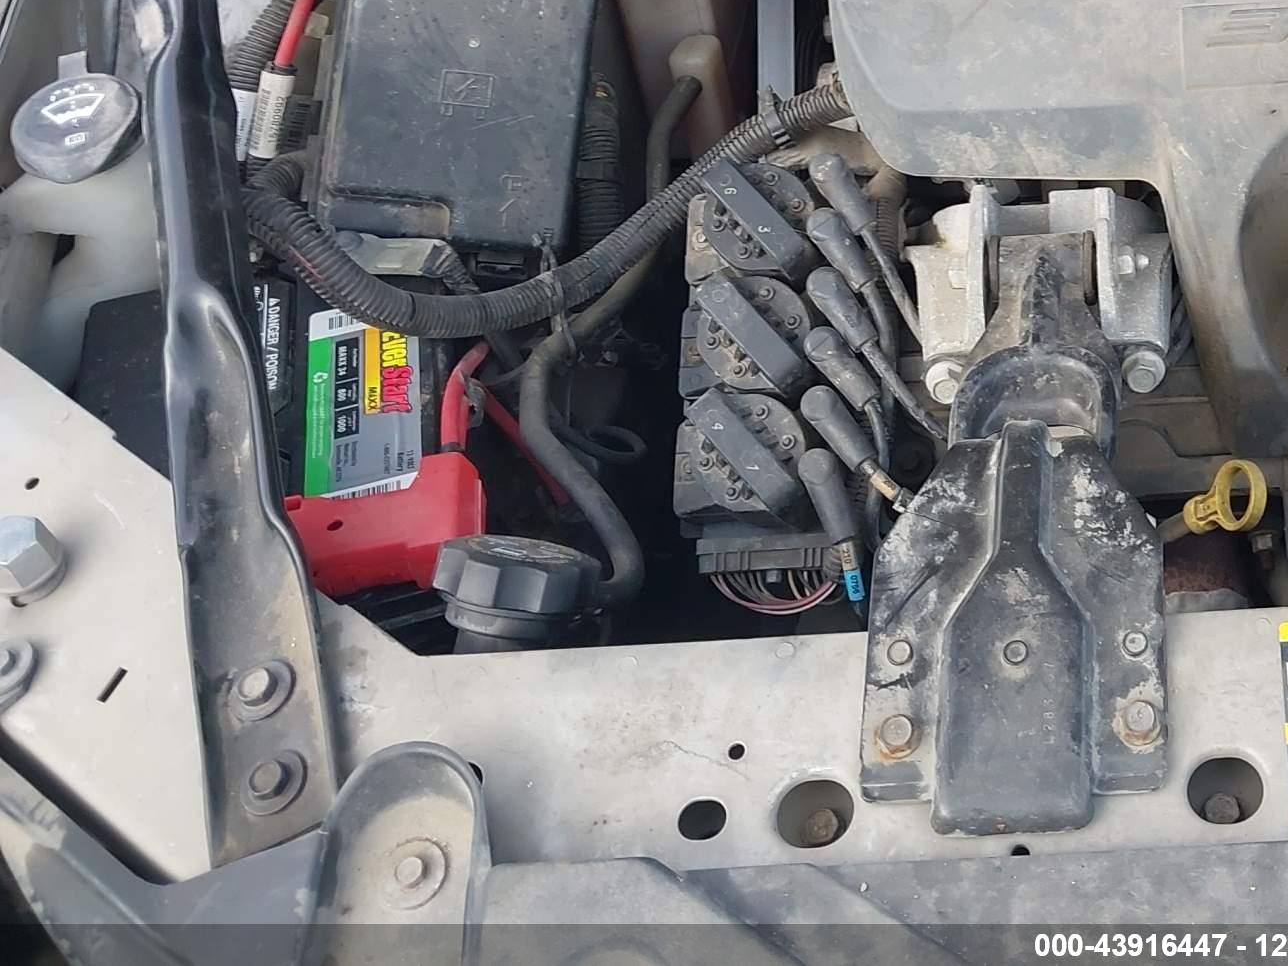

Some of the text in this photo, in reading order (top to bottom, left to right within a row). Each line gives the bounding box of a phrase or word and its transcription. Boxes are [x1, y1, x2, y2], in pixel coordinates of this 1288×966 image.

[724, 187, 737, 195] 6
[757, 225, 771, 233] 3
[267, 306, 280, 344] DANGER
[338, 346, 346, 376] MAXX 34
[368, 387, 378, 411] MAXX
[337, 415, 346, 432] 1000
[711, 422, 724, 430] 4
[842, 549, 852, 564] 210
